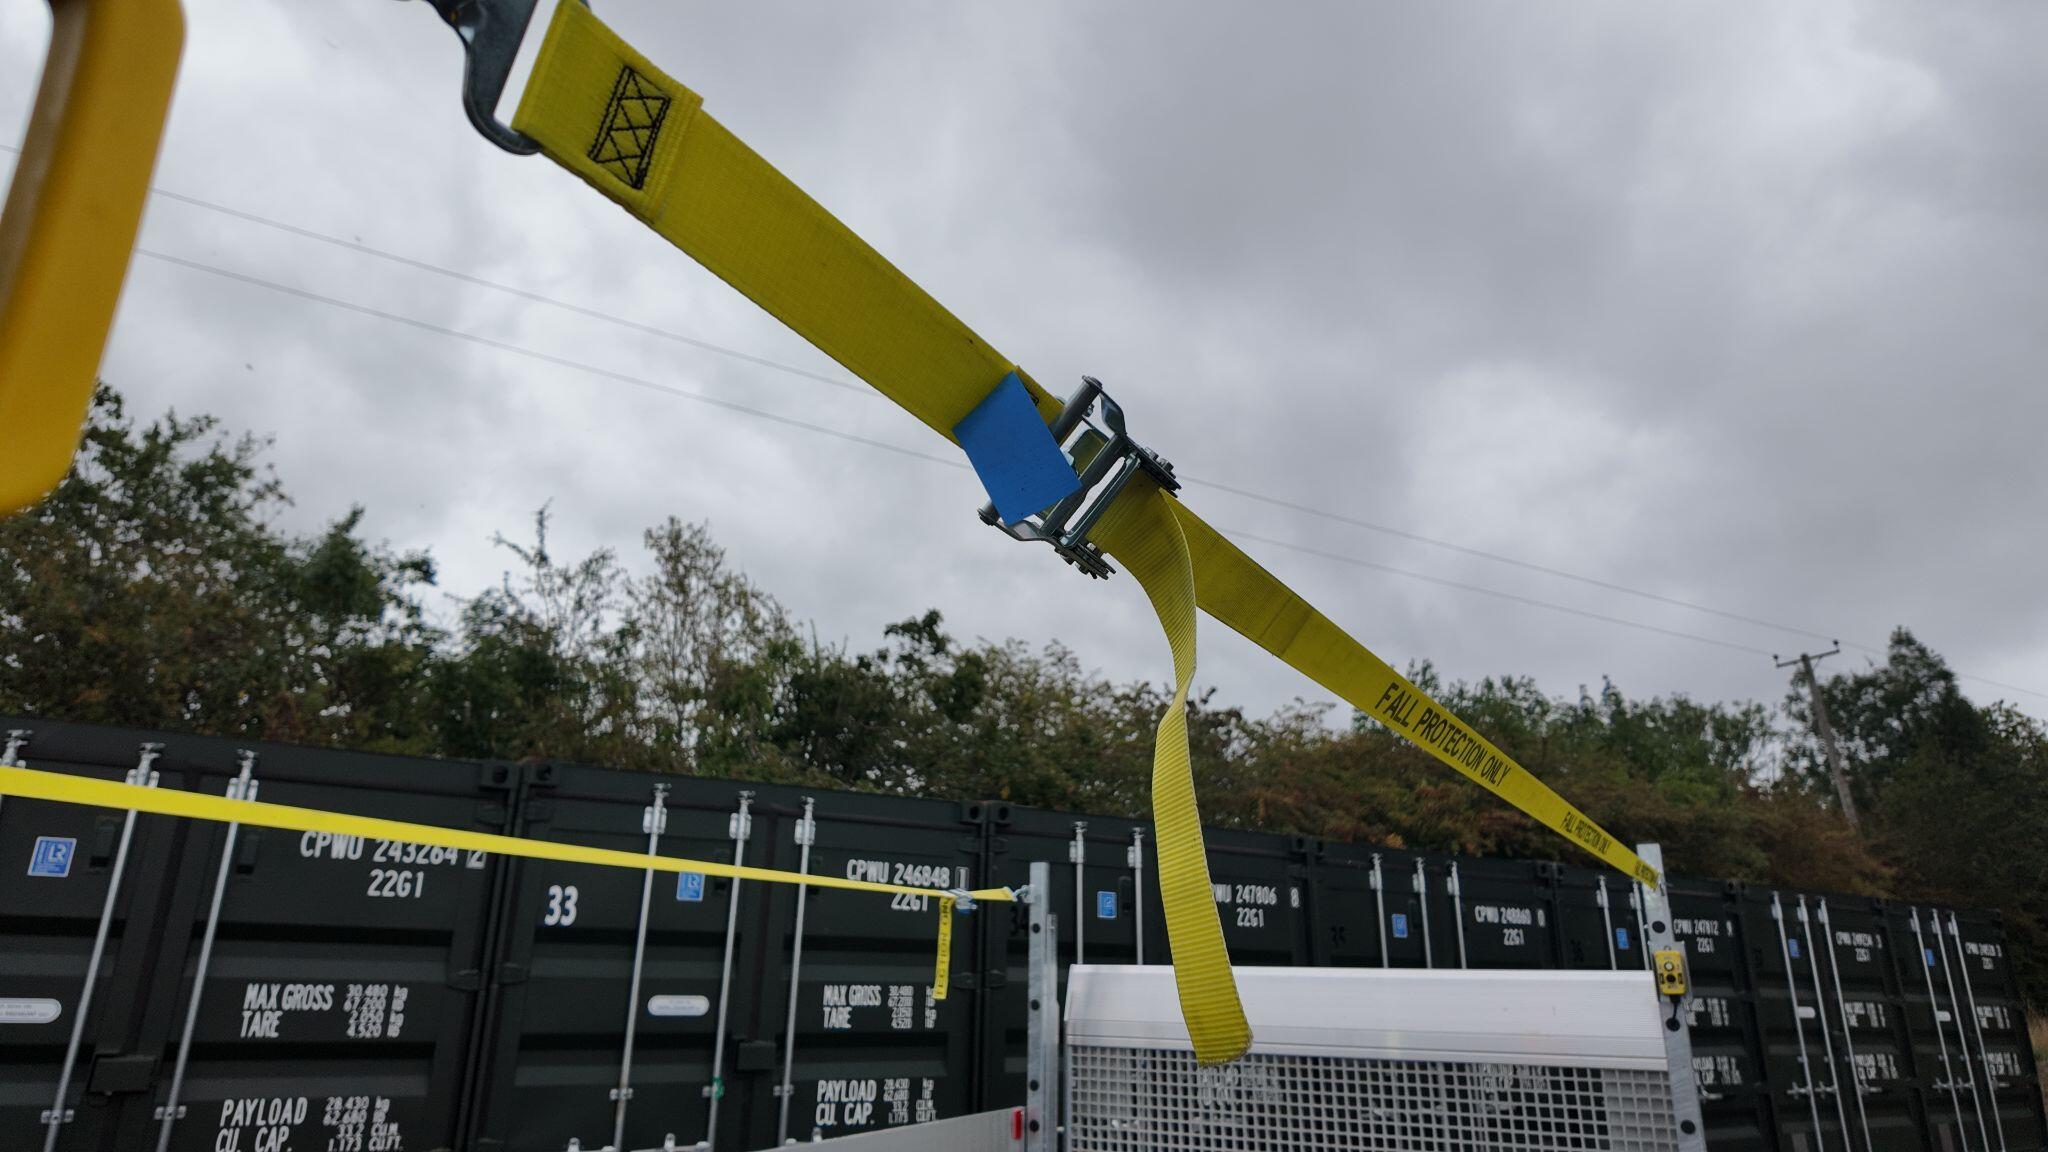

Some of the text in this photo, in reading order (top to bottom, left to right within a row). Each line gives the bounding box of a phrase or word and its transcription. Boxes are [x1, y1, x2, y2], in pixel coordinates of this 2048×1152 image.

[1375, 682, 1511, 787] FALL PROTECTION ONLY
[300, 831, 364, 860] CPWU
[373, 839, 458, 866] 243264
[367, 868, 424, 898] 22G1
[846, 859, 890, 884] CPWU
[893, 863, 950, 888] 246848
[544, 885, 579, 926] 33
[1236, 885, 1278, 906] 247806
[1237, 907, 1265, 928] 22G1
[243, 983, 281, 1010] MAX
[282, 983, 335, 1011] GROSS
[823, 984, 848, 1006] MAX
[848, 984, 882, 1006] GROSS
[240, 1010, 283, 1038] TARE
[823, 1006, 852, 1029] TARE
[816, 1079, 877, 1102] PAYLOAD
[219, 1097, 308, 1127] PAYLOAD
[844, 1102, 875, 1126] CAP.
[254, 1125, 292, 1152] CAP.
